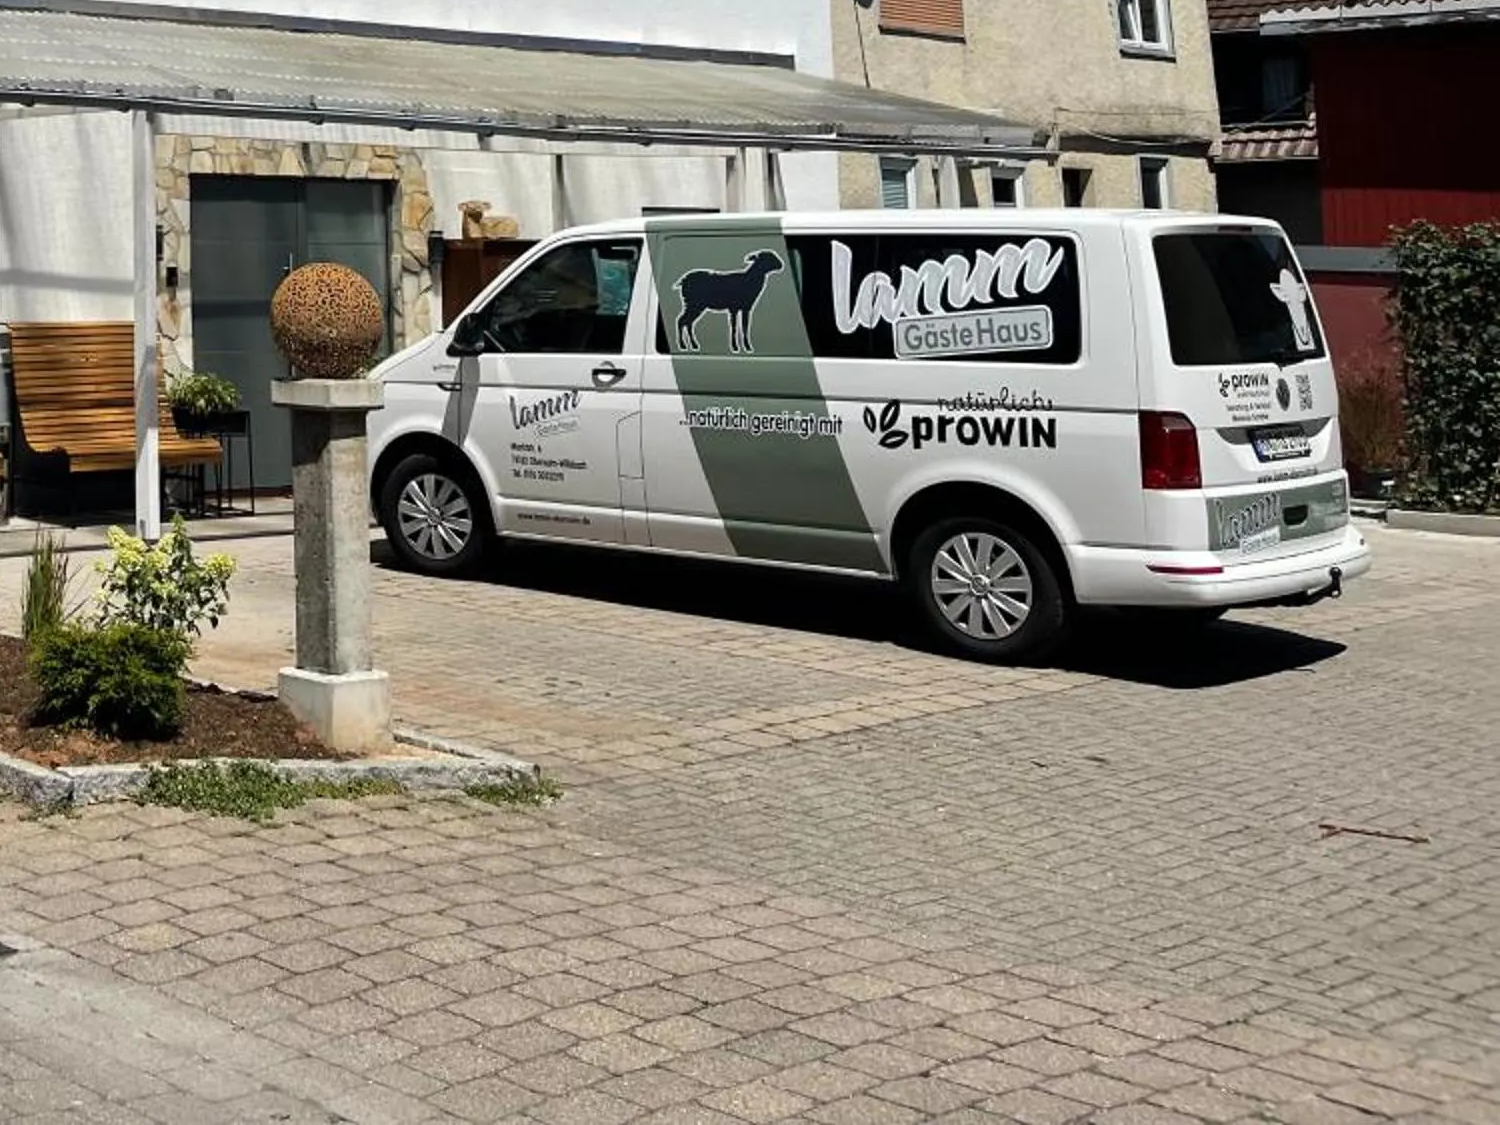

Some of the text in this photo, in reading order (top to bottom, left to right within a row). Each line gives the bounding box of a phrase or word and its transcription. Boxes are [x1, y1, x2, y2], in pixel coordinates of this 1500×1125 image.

[831, 238, 1064, 334] lamm
[509, 389, 580, 430] lamm
[752, 411, 815, 437] gereinigt
[819, 414, 843, 434] mit
[911, 415, 1057, 449] proWIN
